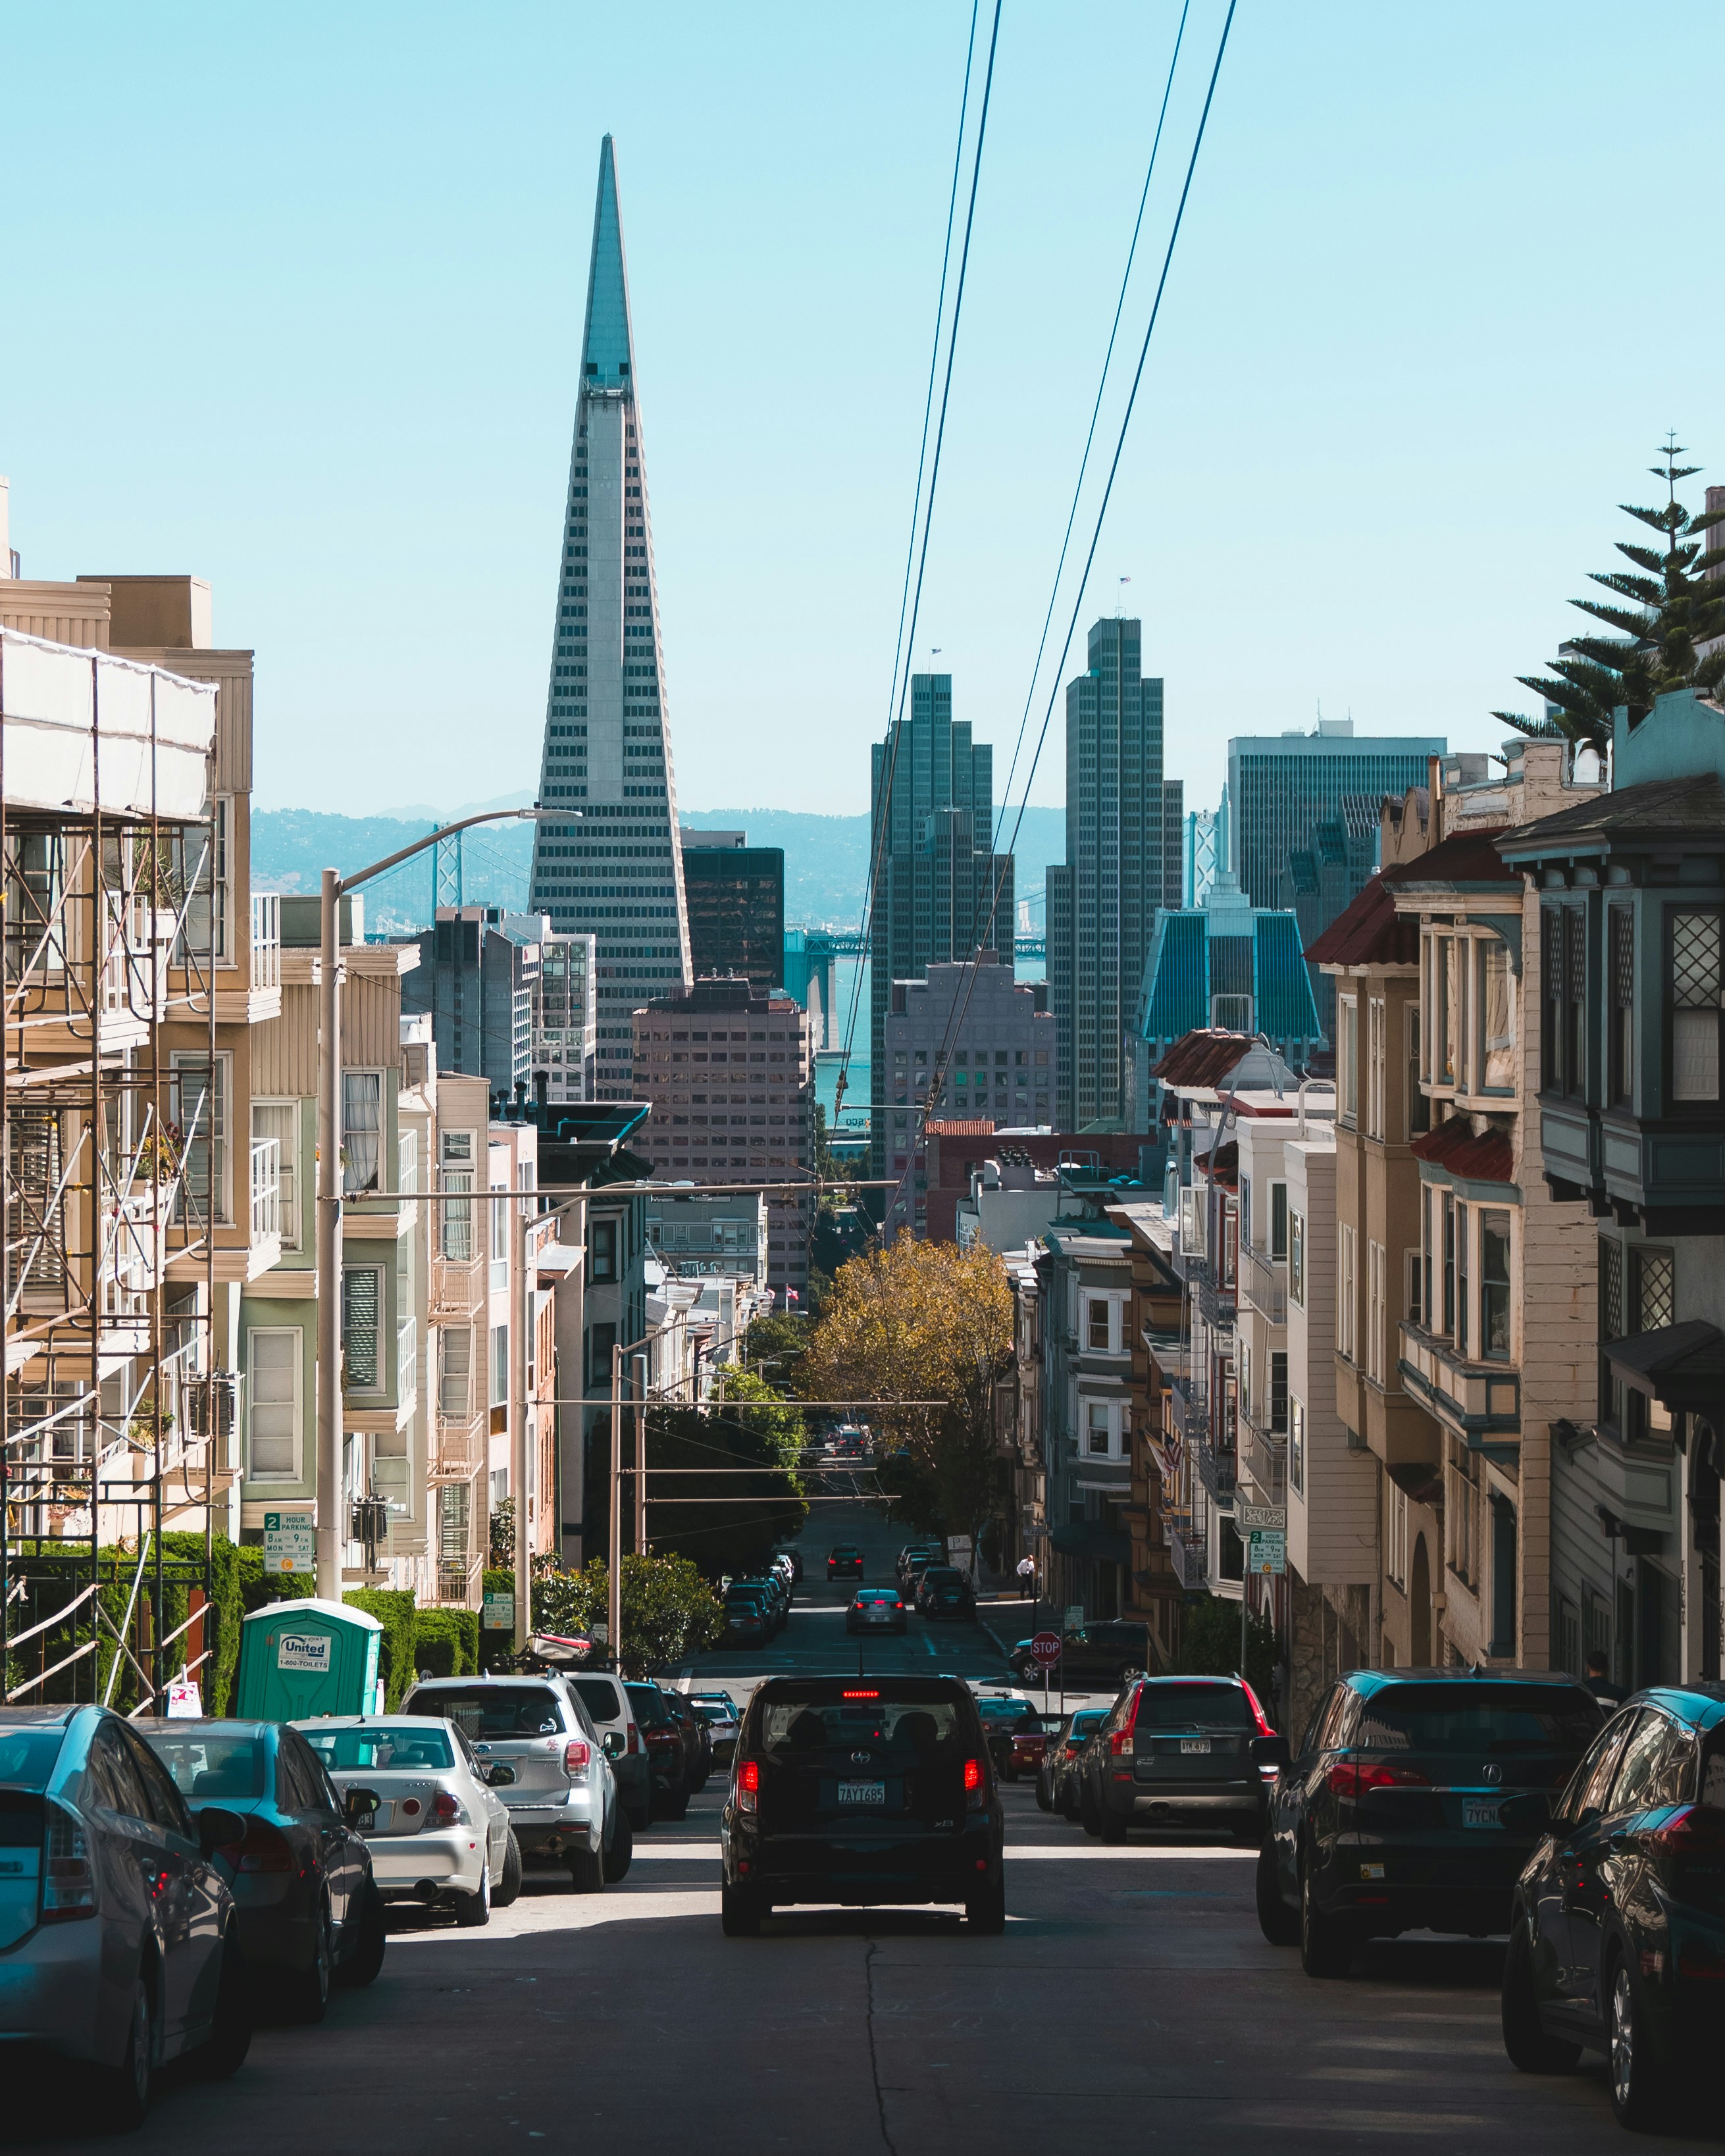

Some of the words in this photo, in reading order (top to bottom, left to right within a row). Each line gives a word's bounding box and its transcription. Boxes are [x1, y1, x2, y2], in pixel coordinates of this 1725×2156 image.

[268, 1517, 276, 1529] 2
[268, 1533, 273, 1543] 8
[294, 1533, 299, 1543] 9
[1252, 1533, 1259, 1542] 2
[286, 1641, 325, 1653] United
[1033, 1642, 1059, 1653] STOP
[280, 1659, 328, 1668] 1-800-TOILETS
[840, 1788, 883, 1801] 7AYT685
